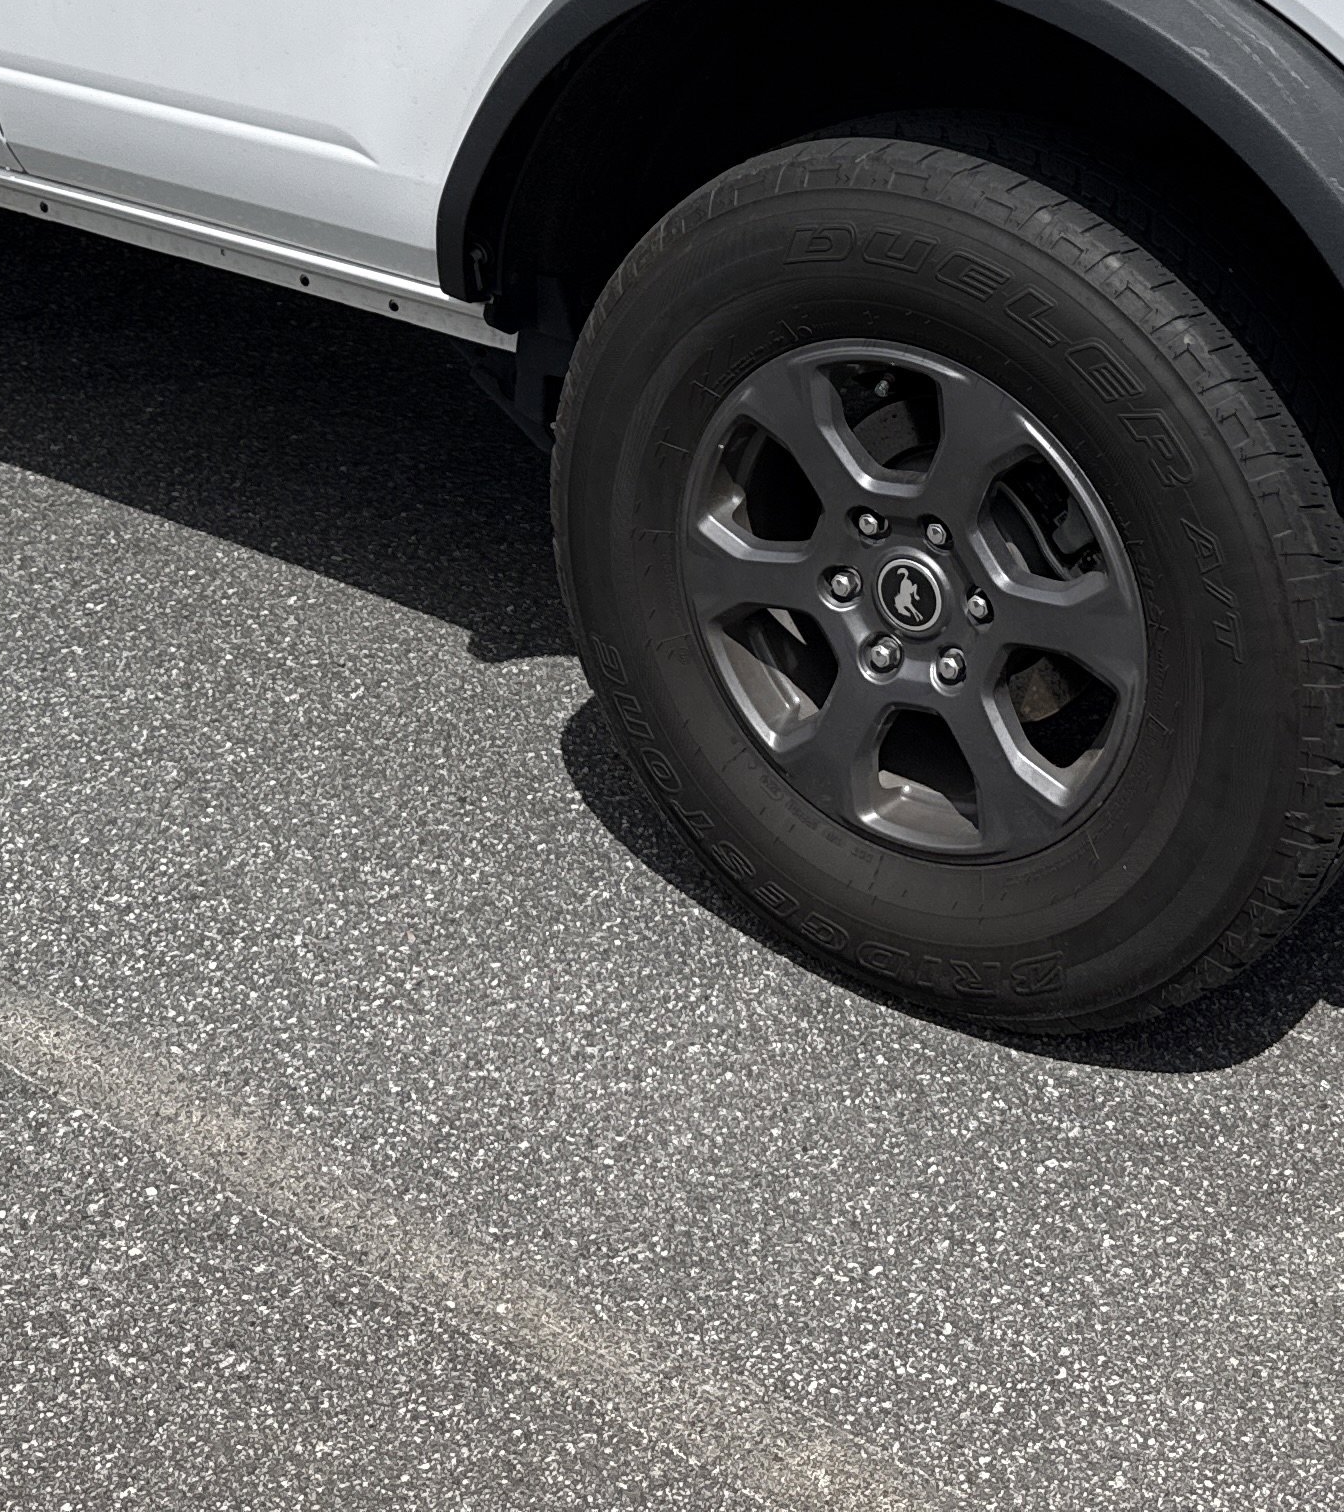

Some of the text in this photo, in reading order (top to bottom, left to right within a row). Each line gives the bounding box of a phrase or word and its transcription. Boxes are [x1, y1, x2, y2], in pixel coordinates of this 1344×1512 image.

[783, 223, 1195, 489] DUELER
[1180, 518, 1247, 665] A/T
[590, 631, 1067, 998] BRIDGESTONE
